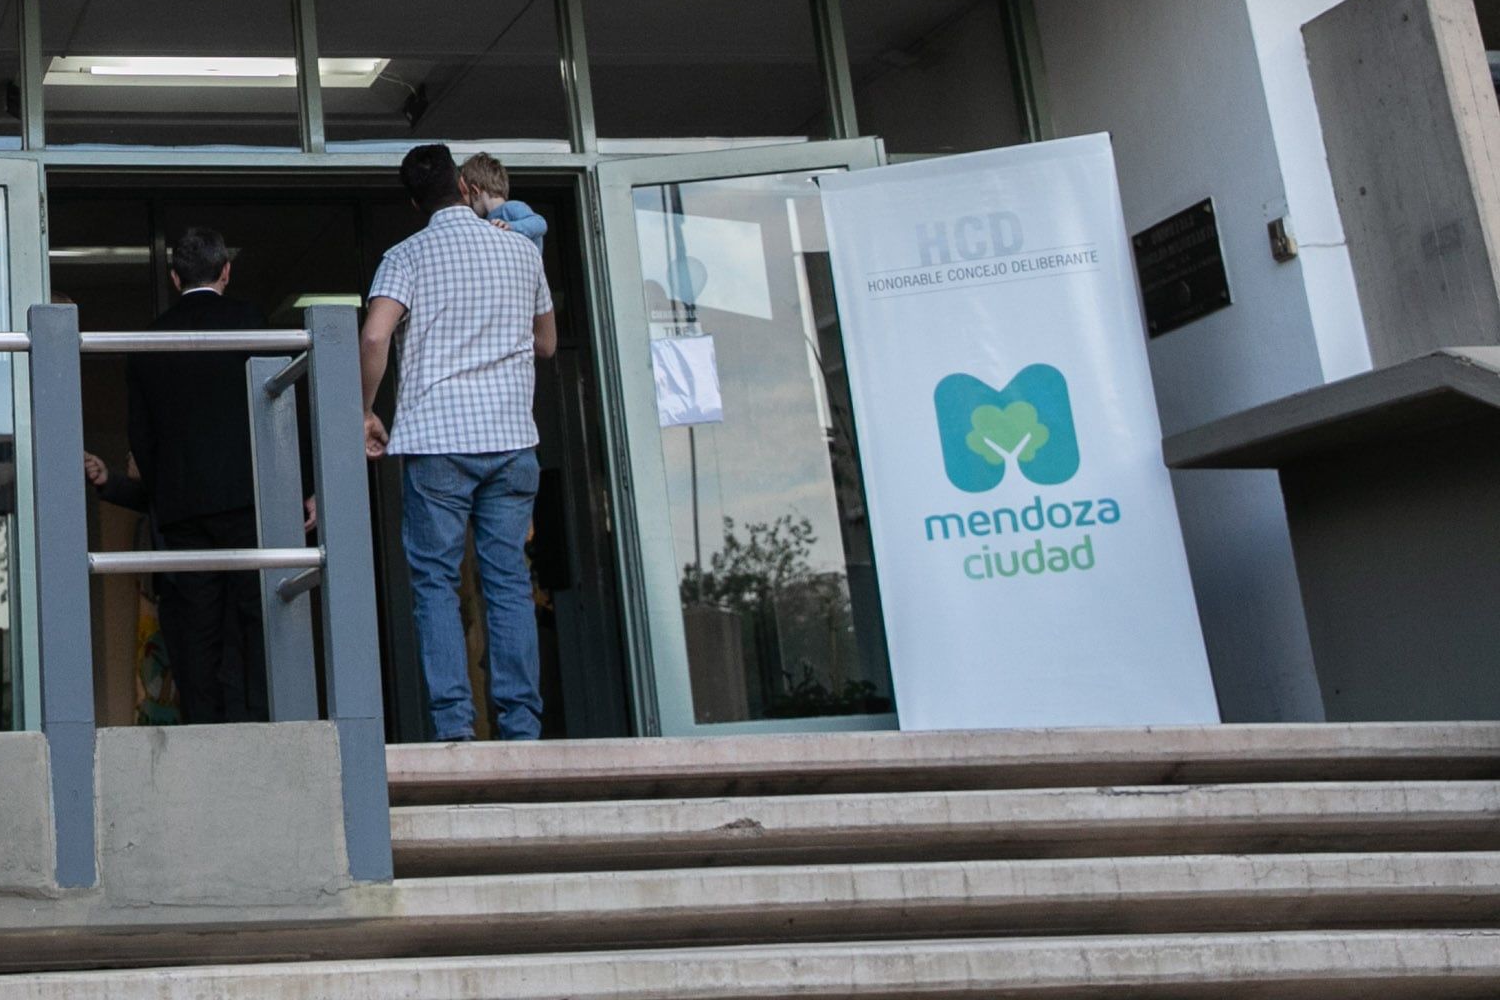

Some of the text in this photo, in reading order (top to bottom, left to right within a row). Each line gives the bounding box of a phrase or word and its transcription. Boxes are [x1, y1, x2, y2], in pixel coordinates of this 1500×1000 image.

[915, 210, 1025, 267] HCD
[867, 249, 1099, 293] HONORABLE CONCEJO DELIBERANTE
[924, 495, 1121, 541] mendoza
[963, 535, 1096, 580] ciudad
